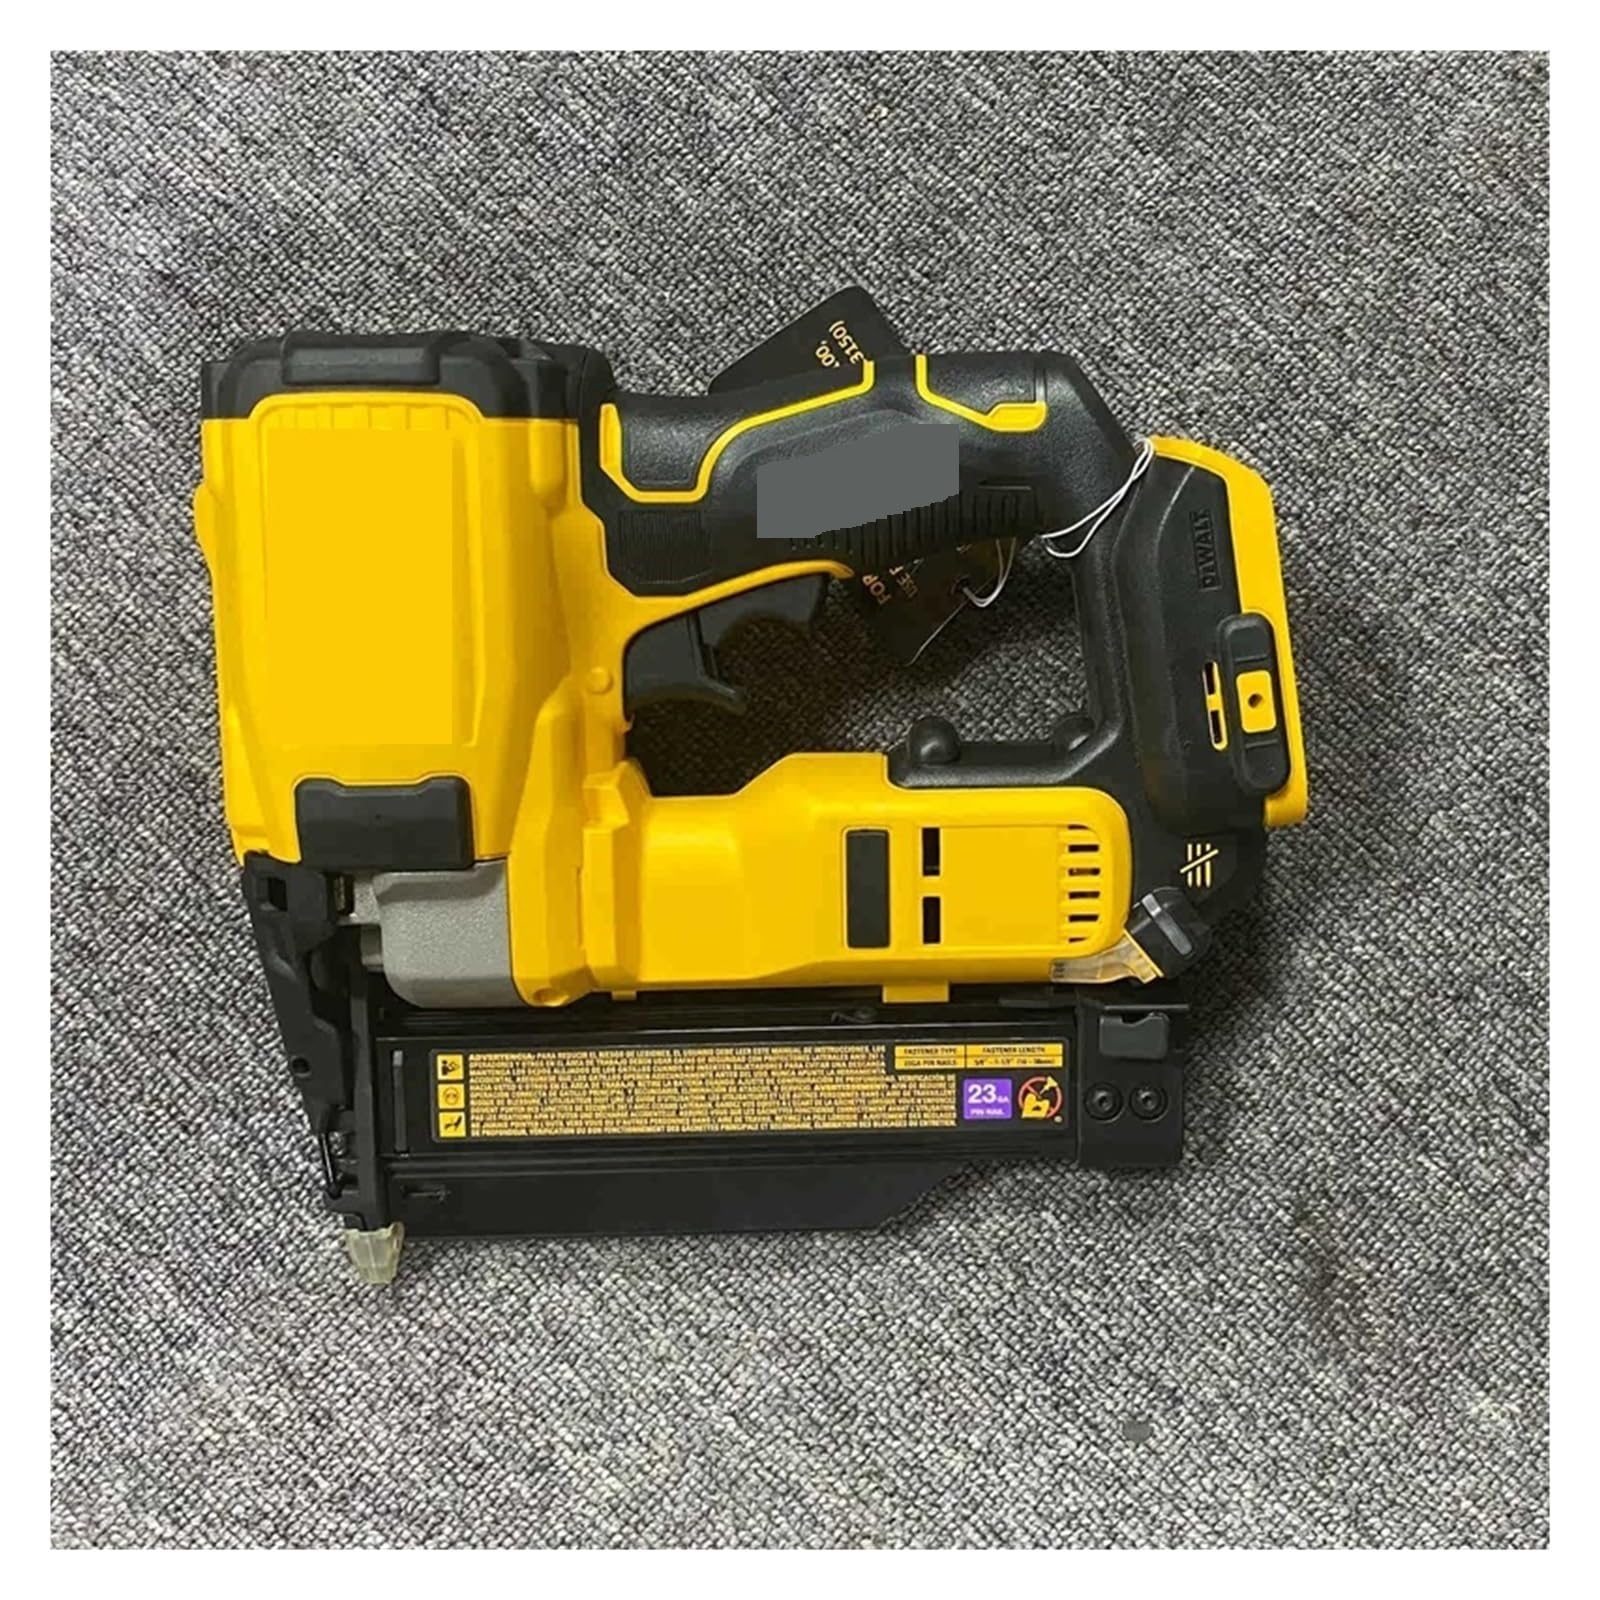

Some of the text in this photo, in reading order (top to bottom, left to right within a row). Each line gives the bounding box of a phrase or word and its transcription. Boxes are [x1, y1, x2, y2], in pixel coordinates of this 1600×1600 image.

[815, 340, 841, 368] 00,
[829, 320, 865, 365] 3150)
[1189, 509, 1218, 590] DEWALT
[968, 1084, 996, 1104] 23
